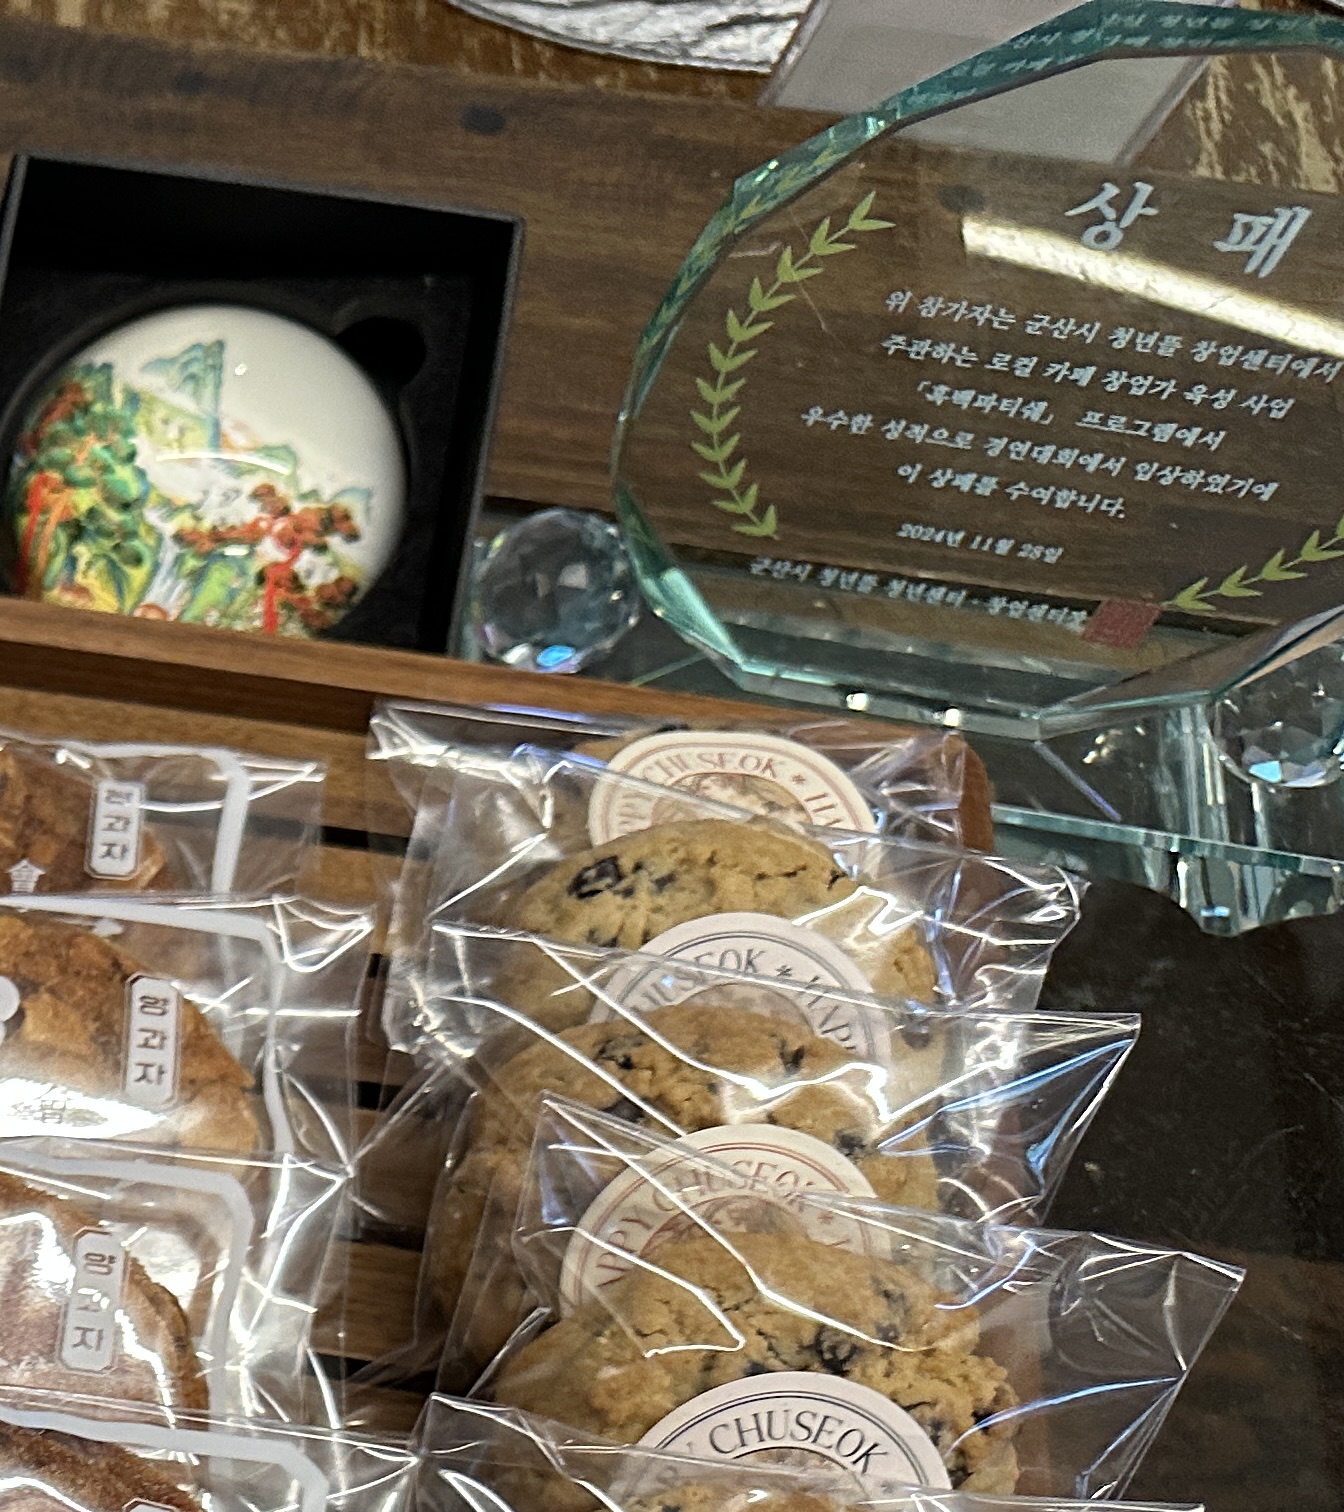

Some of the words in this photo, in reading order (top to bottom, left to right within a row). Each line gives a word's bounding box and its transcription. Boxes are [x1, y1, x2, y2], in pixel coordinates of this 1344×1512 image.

[886, 290, 912, 313] 위
[1024, 313, 1101, 344] 군산시
[1191, 340, 1344, 383] 창업센터에서
[880, 334, 979, 368] 주관하는
[984, 352, 1038, 378] 로컬
[1042, 361, 1096, 387] 카페
[1102, 370, 1177, 400] 창업가
[1184, 384, 1237, 410] 육성
[1239, 394, 1295, 419] 사업
[800, 405, 874, 435] 우수한
[880, 418, 975, 450] 성적으로
[1075, 410, 1227, 452] 프로그램에서
[896, 462, 923, 484] 이
[927, 467, 1000, 497] 상패를
[1004, 480, 1126, 519] 수여합니다.
[709, 1409, 888, 1474] CHUSEOK
